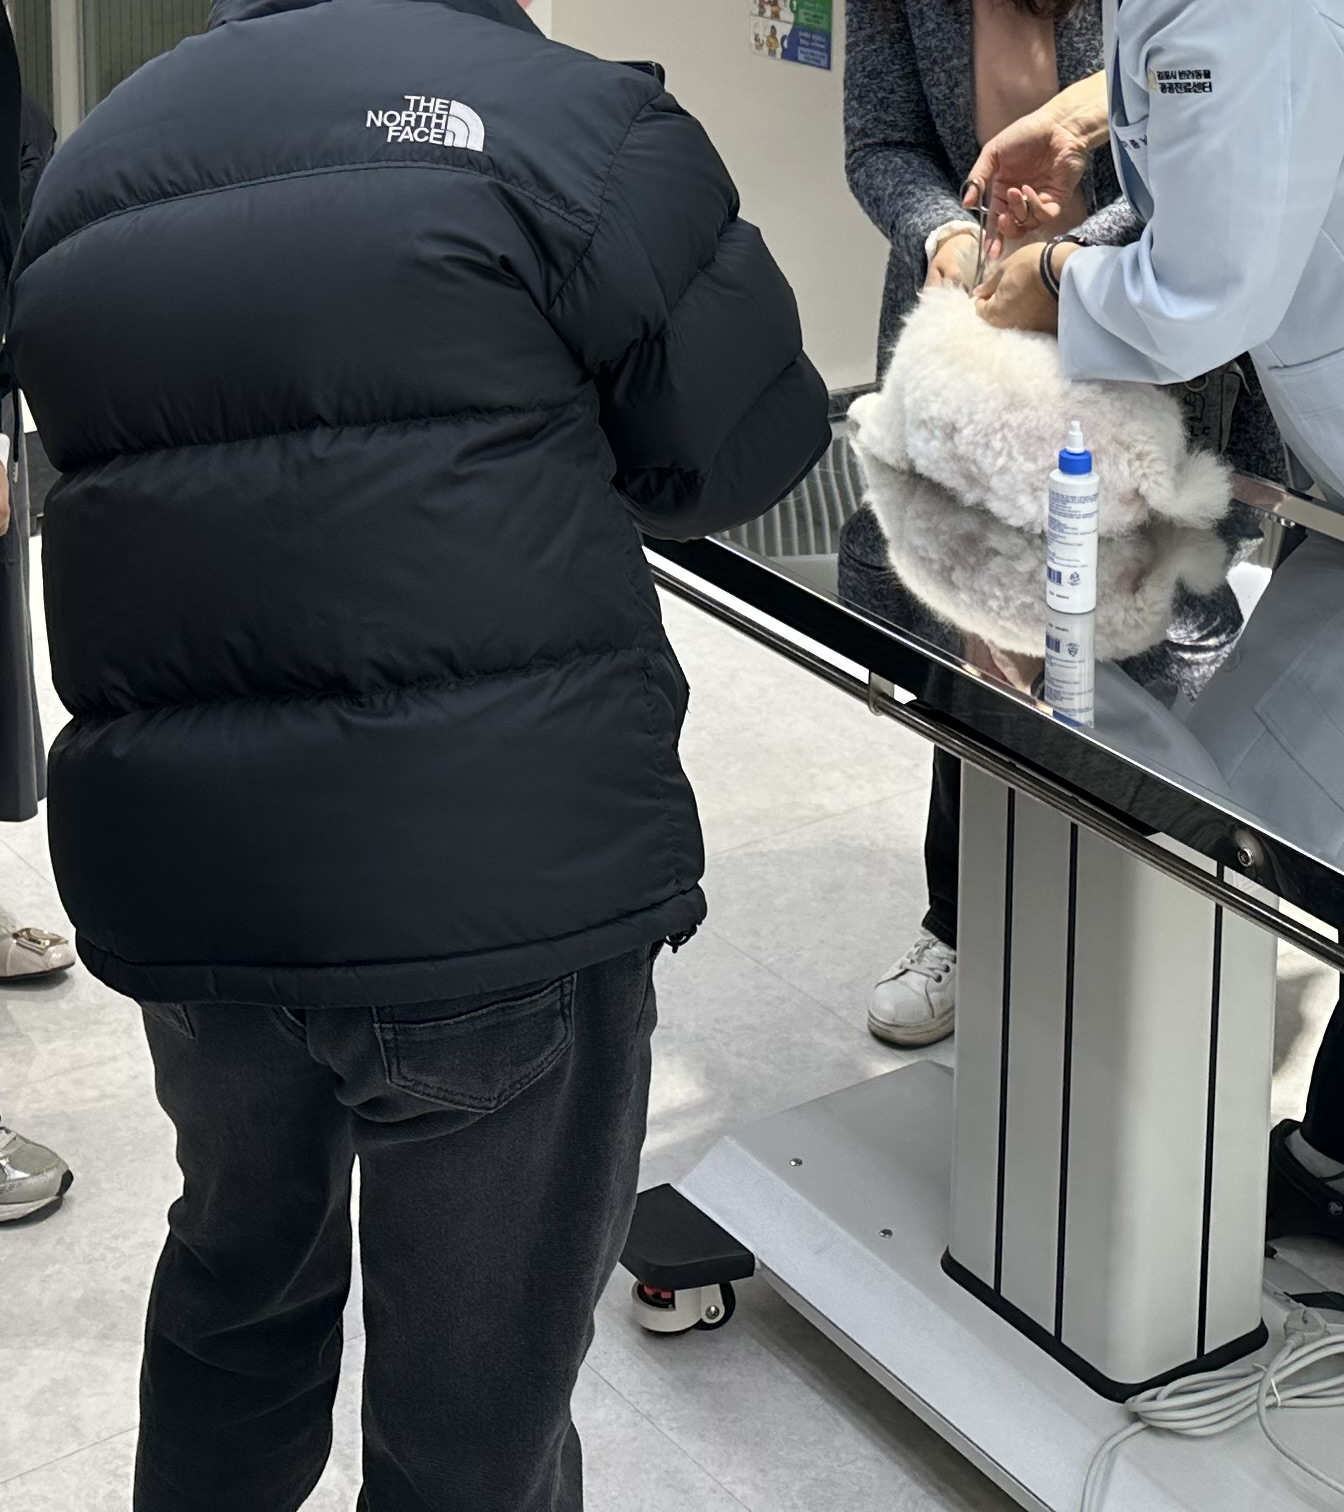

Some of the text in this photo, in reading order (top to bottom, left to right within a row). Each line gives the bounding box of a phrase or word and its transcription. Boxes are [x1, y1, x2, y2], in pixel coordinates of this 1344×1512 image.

[404, 95, 450, 114] THE
[366, 110, 447, 130] NORTH
[387, 126, 444, 145] FACE
